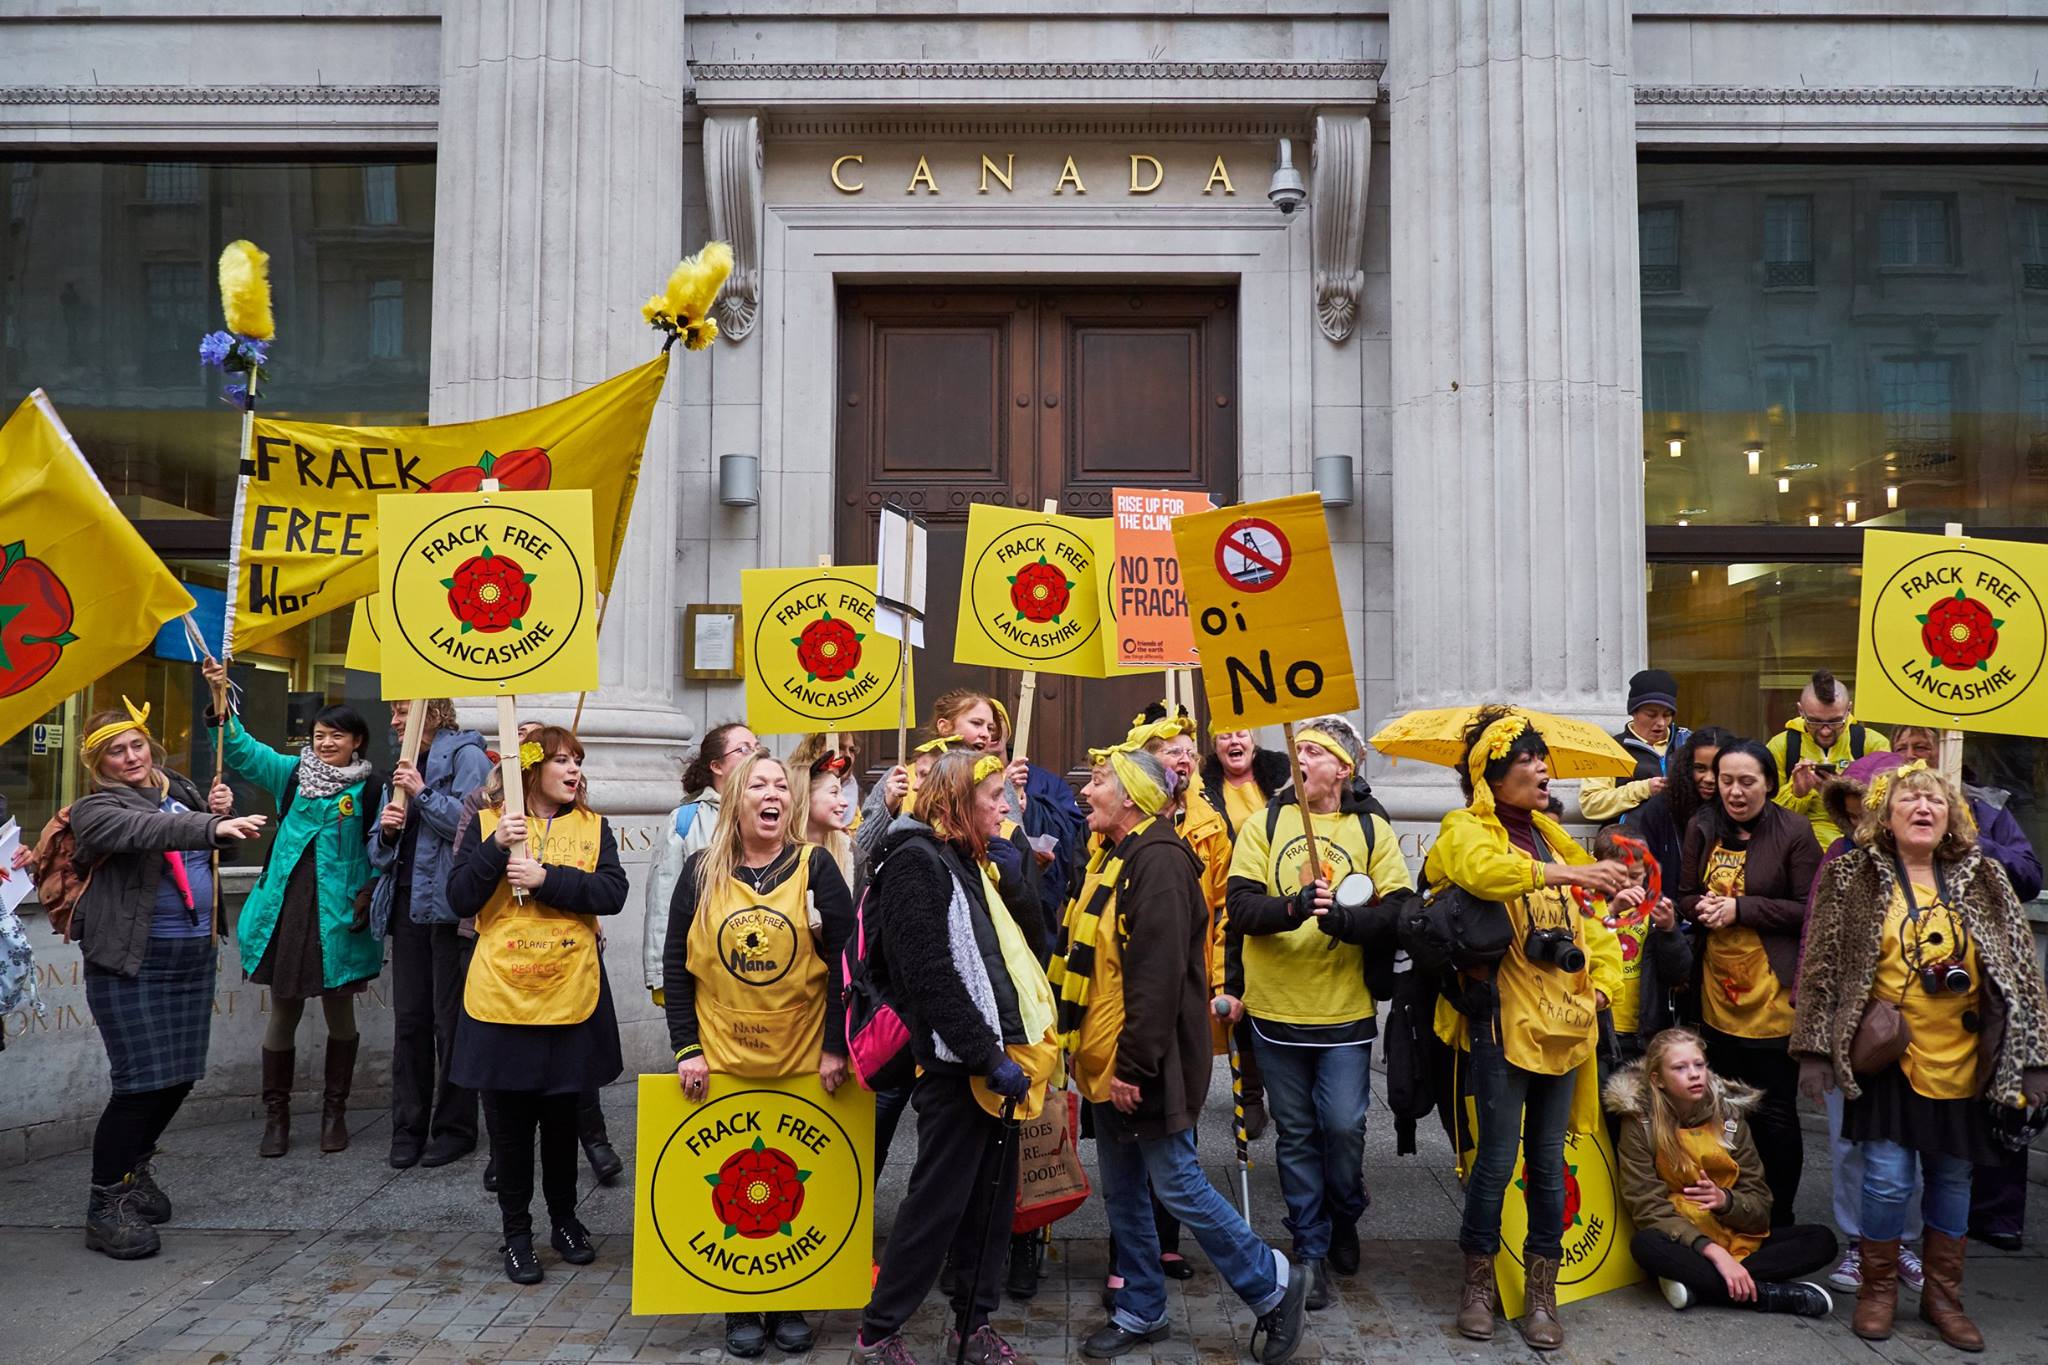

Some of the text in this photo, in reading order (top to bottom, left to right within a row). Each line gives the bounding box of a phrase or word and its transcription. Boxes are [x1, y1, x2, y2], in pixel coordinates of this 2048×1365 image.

[830, 153, 1237, 194] CANADA
[257, 435, 432, 491] FRACK
[1118, 495, 1184, 514] RISE UP FOR
[1118, 513, 1171, 531] THE CLIM
[251, 504, 370, 556] FREE
[421, 523, 553, 564] FRACK FREE
[996, 537, 1089, 573] FRACK FREE
[1120, 556, 1178, 585] NO TO
[1121, 587, 1189, 617] FRACK
[1900, 567, 2021, 608] FRACK FREE
[776, 592, 876, 626] FRACK FREE
[429, 620, 554, 665] LANCASHIRE
[993, 612, 1082, 647] LANCASHIRE
[783, 671, 880, 708] LANCASHIRE
[1225, 649, 1324, 716] No
[1901, 659, 2017, 701] LANCASHIRE
[1285, 842, 1310, 860] FRAC
[729, 914, 786, 932] FRACK FREE
[517, 938, 556, 950] PLANET
[731, 948, 777, 974] Nana
[685, 1111, 831, 1157] FRACK FREE
[1020, 1122, 1053, 1141] HOES
[688, 1225, 827, 1276] LANCASHIRE
[1558, 1213, 1604, 1267] ASHIRE
